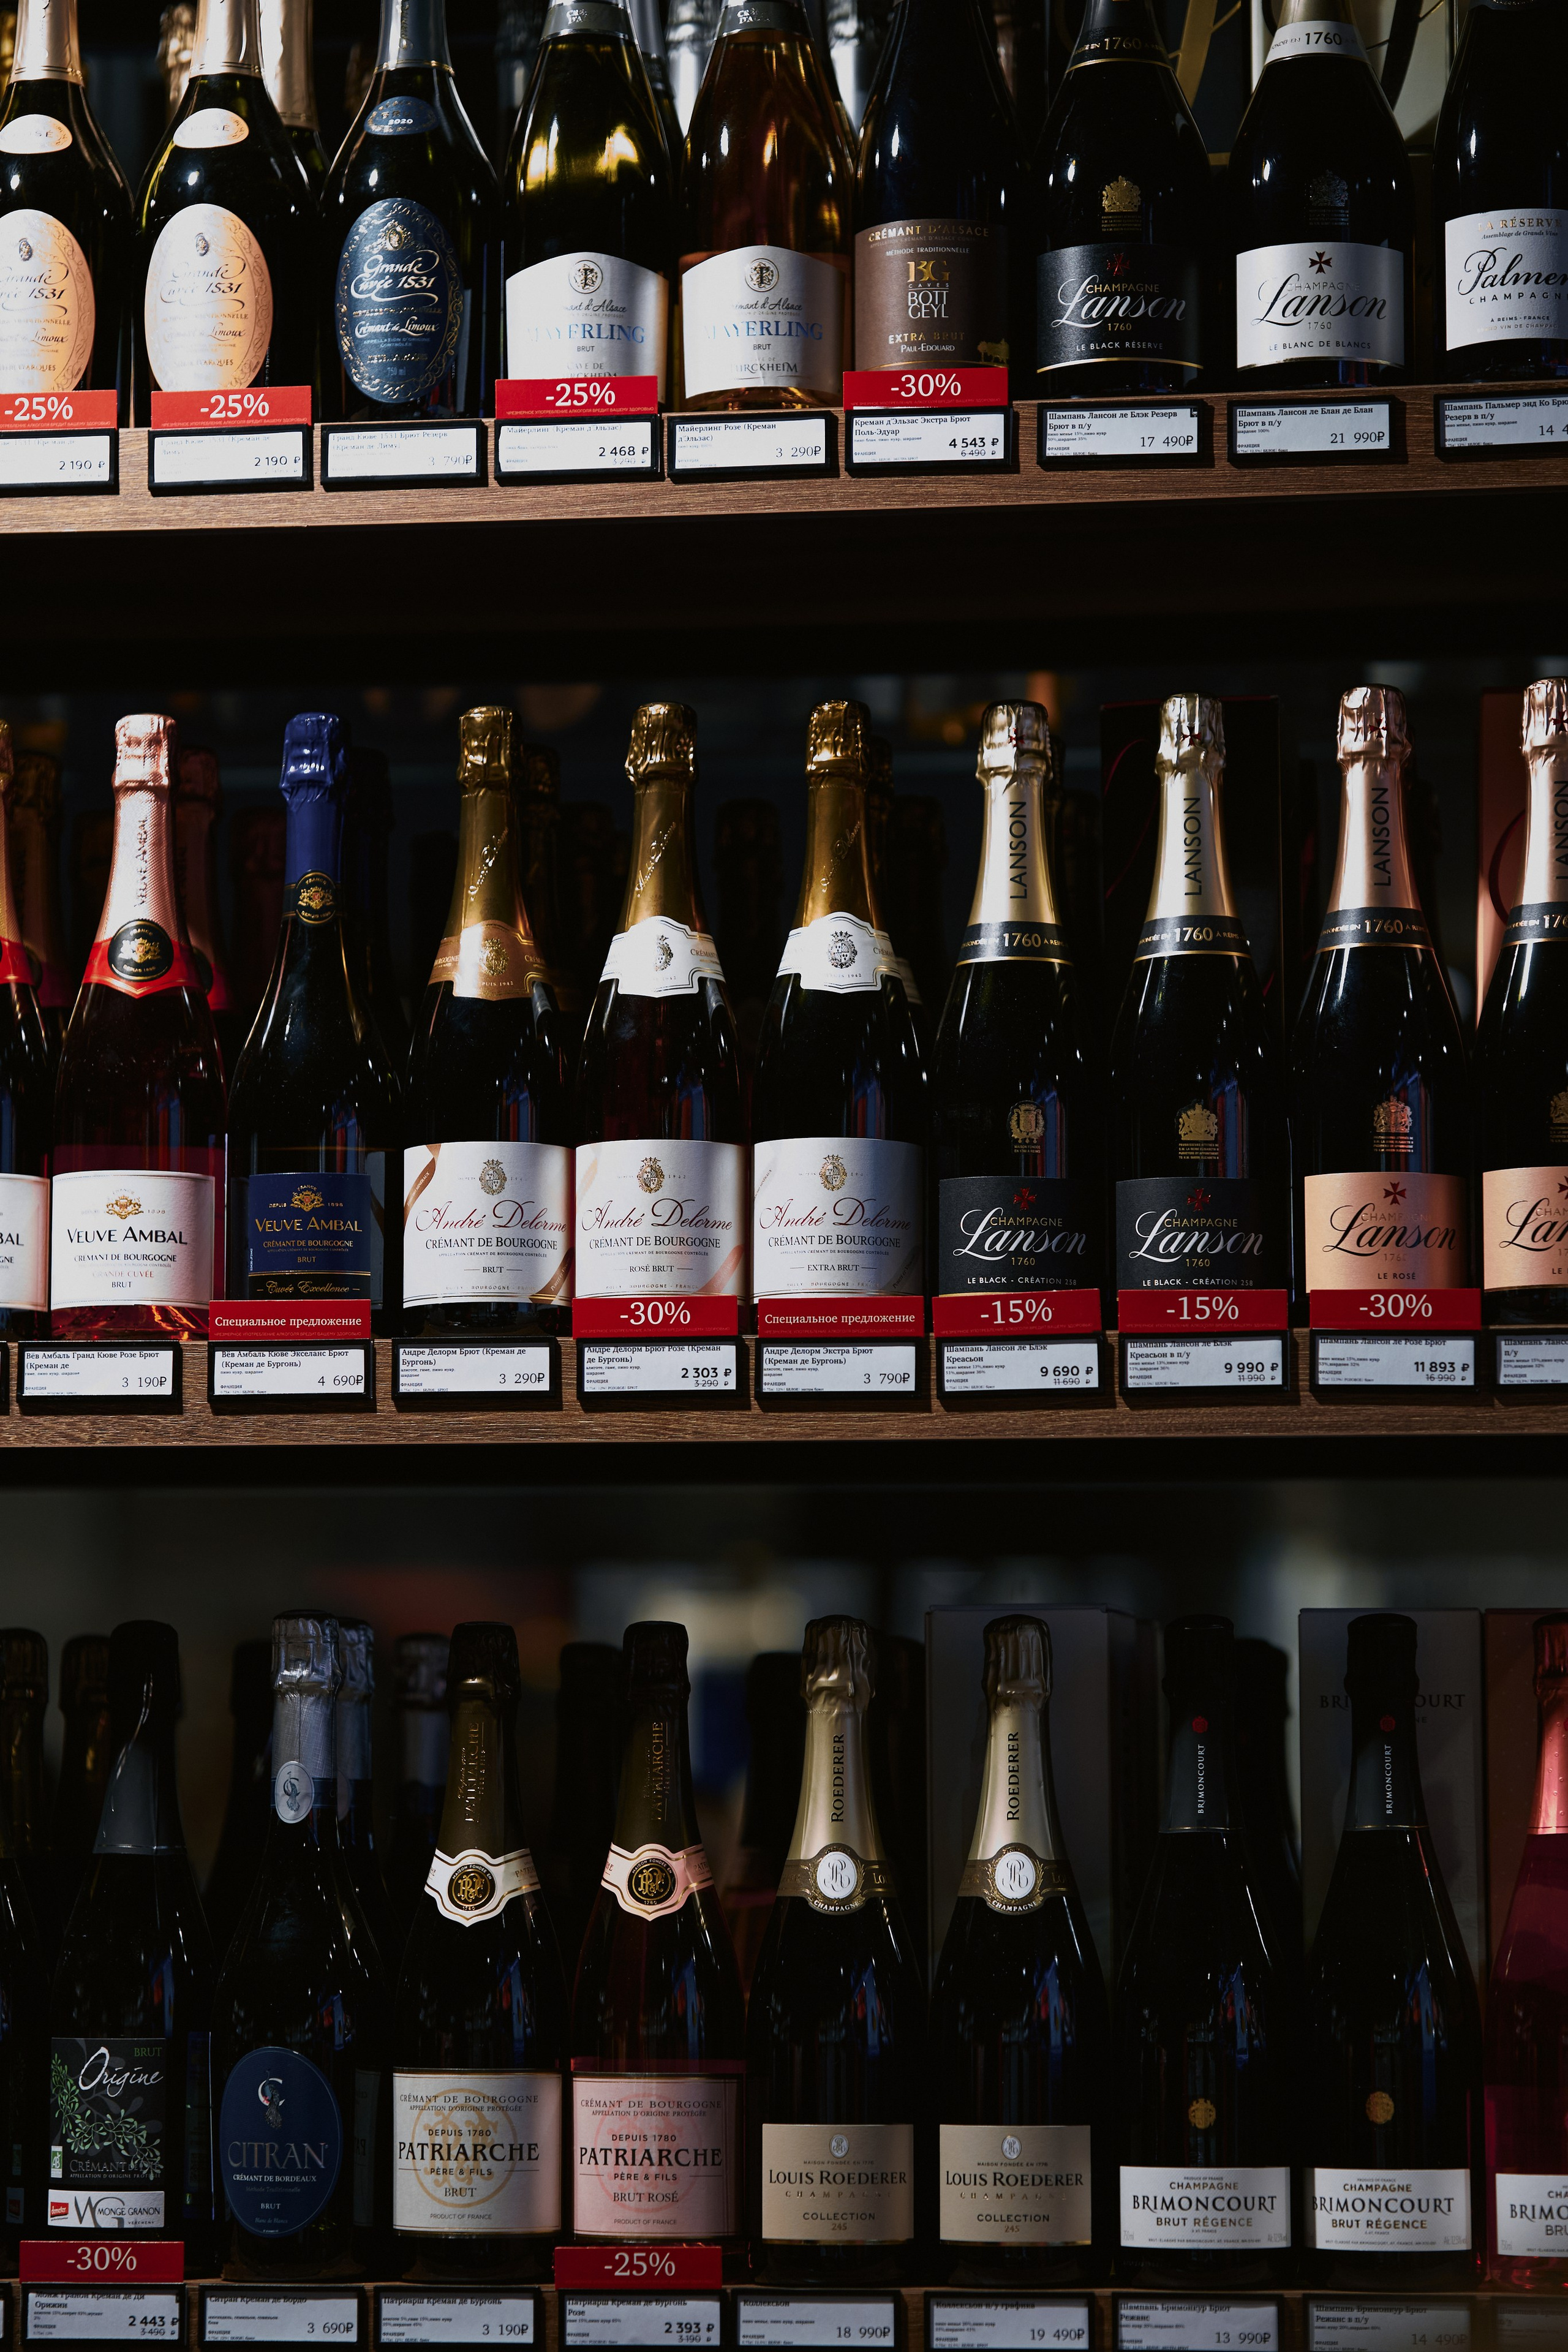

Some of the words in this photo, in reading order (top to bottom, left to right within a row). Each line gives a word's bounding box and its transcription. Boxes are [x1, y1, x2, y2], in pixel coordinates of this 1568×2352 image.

[1104, 37, 1141, 50] 1760
[1305, 32, 1342, 45] 1760
[869, 226, 921, 241] CRÉMANT
[364, 250, 439, 273] Grande
[397, 277, 434, 288] 1531
[1086, 282, 1160, 293] CHAMPAGNE
[908, 291, 948, 305] BOTT
[1051, 275, 1186, 328] Lanson
[1251, 274, 1387, 326] Lanson
[355, 322, 391, 338] Crémant
[392, 323, 400, 331] de
[400, 316, 439, 337] Limoux
[889, 333, 925, 344] EXTRA
[934, 332, 965, 341] BRUT
[1335, 341, 1371, 349] BLANCS
[891, 374, 962, 398] -30%
[546, 383, 615, 407] -25%
[4, 397, 73, 421] -25%
[200, 393, 270, 418] -25%
[921, 416, 948, 424] Экстра
[950, 415, 971, 424] Брют
[1238, 409, 1276, 418] Шампань
[678, 425, 722, 434] Майерлинг
[725, 423, 742, 432] Розе
[744, 423, 776, 431] (Креман
[1238, 419, 1259, 429] Брют
[1268, 419, 1282, 428] п/у
[855, 427, 899, 437] Поль-Эдуар
[1330, 432, 1344, 443] 21
[949, 437, 957, 448] 4
[960, 437, 986, 448] 543
[1141, 436, 1155, 447] 17
[599, 447, 606, 457] 2
[611, 446, 636, 456] 468
[776, 448, 783, 458] 3
[1371, 788, 1391, 886] LANSON
[1009, 802, 1027, 899] LANSON
[1183, 797, 1202, 895] LANSON
[415, 1201, 486, 1231] André
[492, 1200, 567, 1232] Delorme
[990, 1217, 1063, 1227] CHAMPAGNE
[255, 1218, 303, 1232] VEUVE
[306, 1216, 363, 1232] AMBAL
[1322, 1203, 1458, 1256] Lanson
[67, 1229, 118, 1244] VEUVE
[123, 1226, 187, 1245] AMBAL
[953, 1207, 1087, 1261] Lanson
[1129, 1208, 1263, 1262] Lanson
[266, 1281, 294, 1294] Cuvée
[298, 1280, 350, 1294] Excellence
[981, 1299, 1052, 1324] -15%
[1167, 1296, 1239, 1320] -15%
[1359, 1294, 1433, 1318] -30%
[620, 1302, 690, 1326] -30%
[765, 1314, 838, 1325] Специальное
[841, 1313, 915, 1325] предложение
[215, 1317, 286, 1327] Специальное
[289, 1316, 361, 1328] предложение
[72, 1352, 96, 1361] Гранд
[120, 1351, 137, 1360] Розе
[139, 1351, 159, 1360] Брют
[681, 1368, 689, 1378] 2
[692, 1367, 718, 1378] 303
[1040, 1366, 1048, 1377] 9
[1051, 1366, 1080, 1376] 690
[1224, 1363, 1232, 1373] 9
[1237, 1362, 1264, 1373] 990
[1414, 1362, 1425, 1372] 11
[1429, 1362, 1455, 1372] 893
[123, 1377, 129, 1388] 3
[318, 1376, 325, 1386] 4
[499, 1374, 506, 1384] 3
[864, 1374, 870, 1384] 3
[831, 1733, 845, 1823] ROEDERER
[1006, 1732, 1020, 1820] ROEDERER
[1197, 1744, 1206, 1814] BRIMONCOURT
[1384, 1744, 1393, 1814] BRIMONCOURT
[134, 2048, 162, 2057] BRUT
[78, 2046, 164, 2097] Origine
[228, 2142, 326, 2169] CITRAN
[399, 2143, 540, 2162] PATRIARCHE
[579, 2148, 723, 2166] PATRIARCHE
[769, 2169, 814, 2184] LOUIS
[820, 2169, 907, 2185] ROEDERER
[946, 2171, 988, 2187] LOUIS
[992, 2173, 1083, 2187] ROEDERER
[1170, 2182, 1238, 2190] CHAMPAGNE
[613, 2192, 644, 2203] BRUT
[648, 2190, 679, 2203] ROSÉ
[97, 2206, 126, 2216] MONGE
[128, 2206, 160, 2216] GRANON
[1133, 2195, 1277, 2214] BRIMONCOURT
[1312, 2196, 1454, 2216] BRIMONCOURT
[802, 2212, 875, 2221] COLLECTION
[1156, 2218, 1188, 2227] BRUT
[1194, 2216, 1253, 2227] RÉGENCE
[67, 2247, 137, 2271] -30%
[605, 2252, 676, 2277] -25%
[129, 2316, 136, 2326] 2
[139, 2316, 165, 2326] 443
[307, 2323, 314, 2334] 3
[665, 2323, 672, 2333] 2
[675, 2323, 701, 2334] 393
[837, 2326, 851, 2339] 18
[1216, 2332, 1230, 2343] 13
